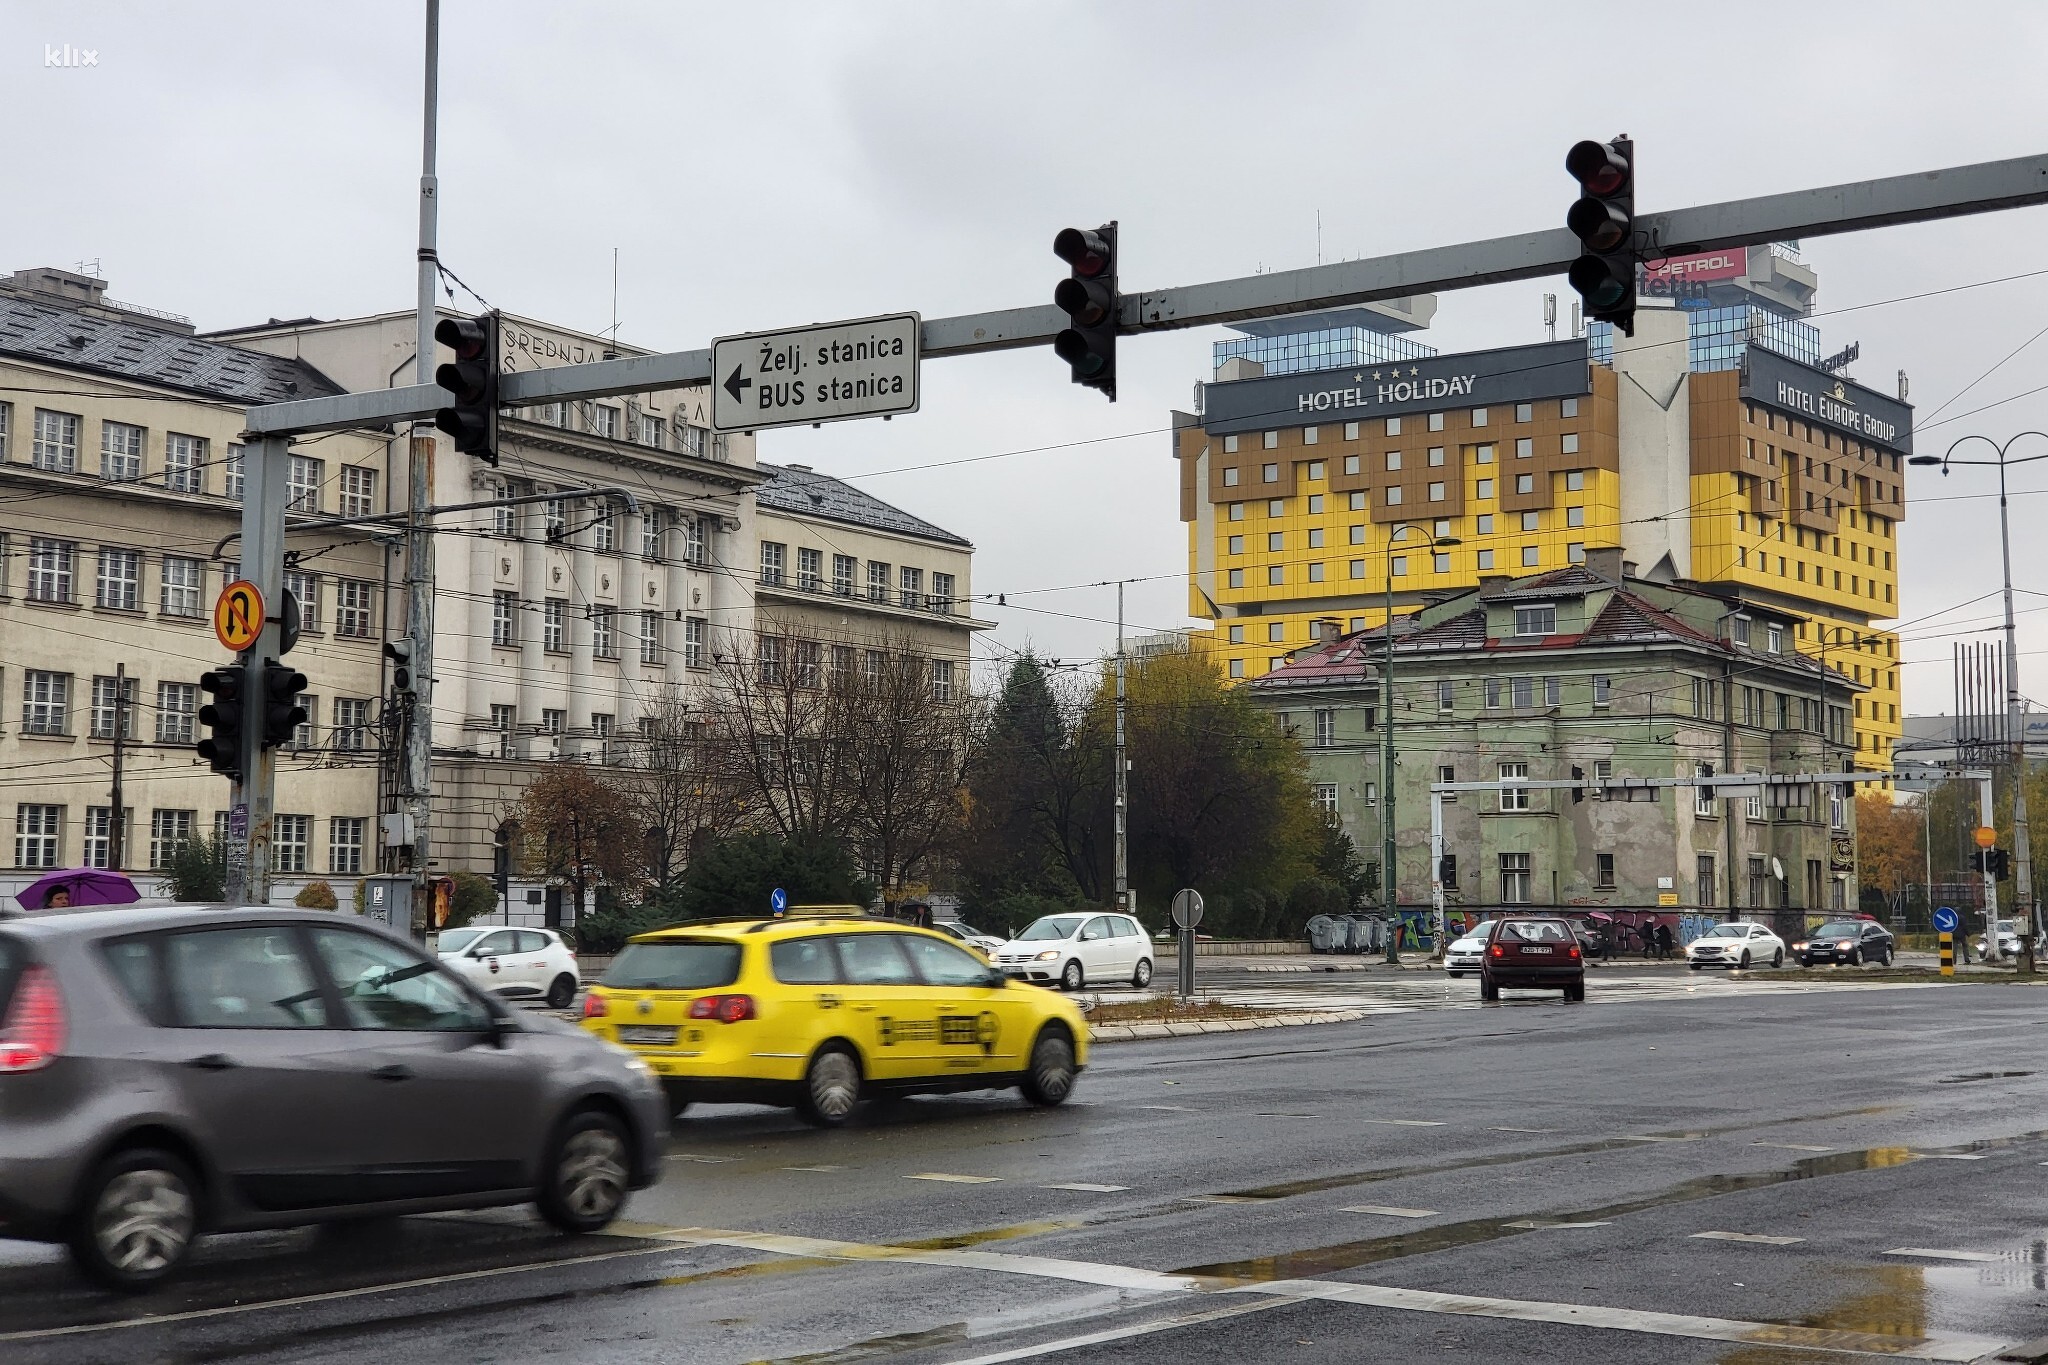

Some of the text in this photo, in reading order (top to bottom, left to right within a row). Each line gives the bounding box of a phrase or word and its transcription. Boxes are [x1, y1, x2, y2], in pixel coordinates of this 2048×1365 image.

[1658, 256, 1734, 277] PETROL
[505, 330, 595, 364] SREDNJA
[759, 335, 903, 375] Želj. stanica
[759, 373, 903, 409] BUS stanica
[1298, 374, 1477, 412] HOTEL HOLIDAY
[1777, 381, 1895, 442] HOTEL EUROPE GROUP
